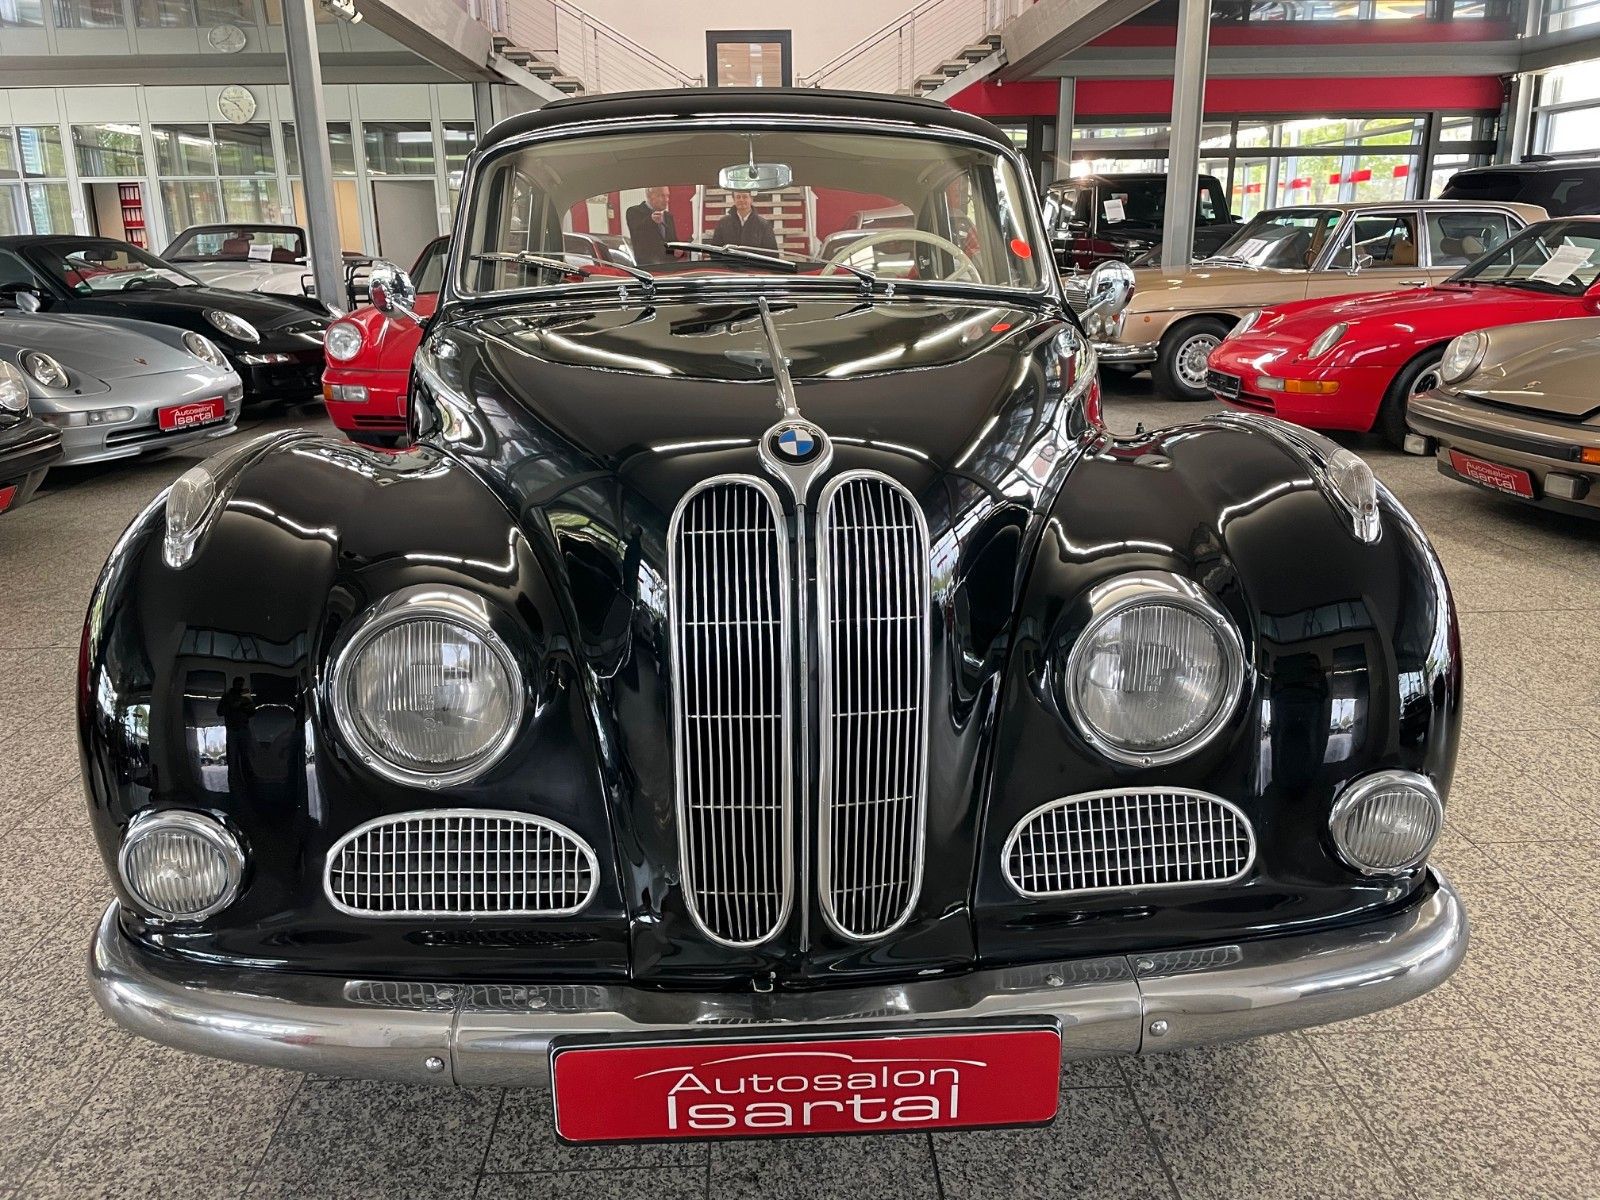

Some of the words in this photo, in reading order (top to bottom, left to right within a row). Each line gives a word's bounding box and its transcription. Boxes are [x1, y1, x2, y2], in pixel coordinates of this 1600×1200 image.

[174, 406, 214, 426] Isartal
[175, 406, 212, 416] Autosalon
[1466, 461, 1514, 479] Autosalon
[1467, 466, 1516, 490] Isartal
[668, 1066, 959, 1095] Autosalon
[667, 1084, 959, 1130] Isartal
